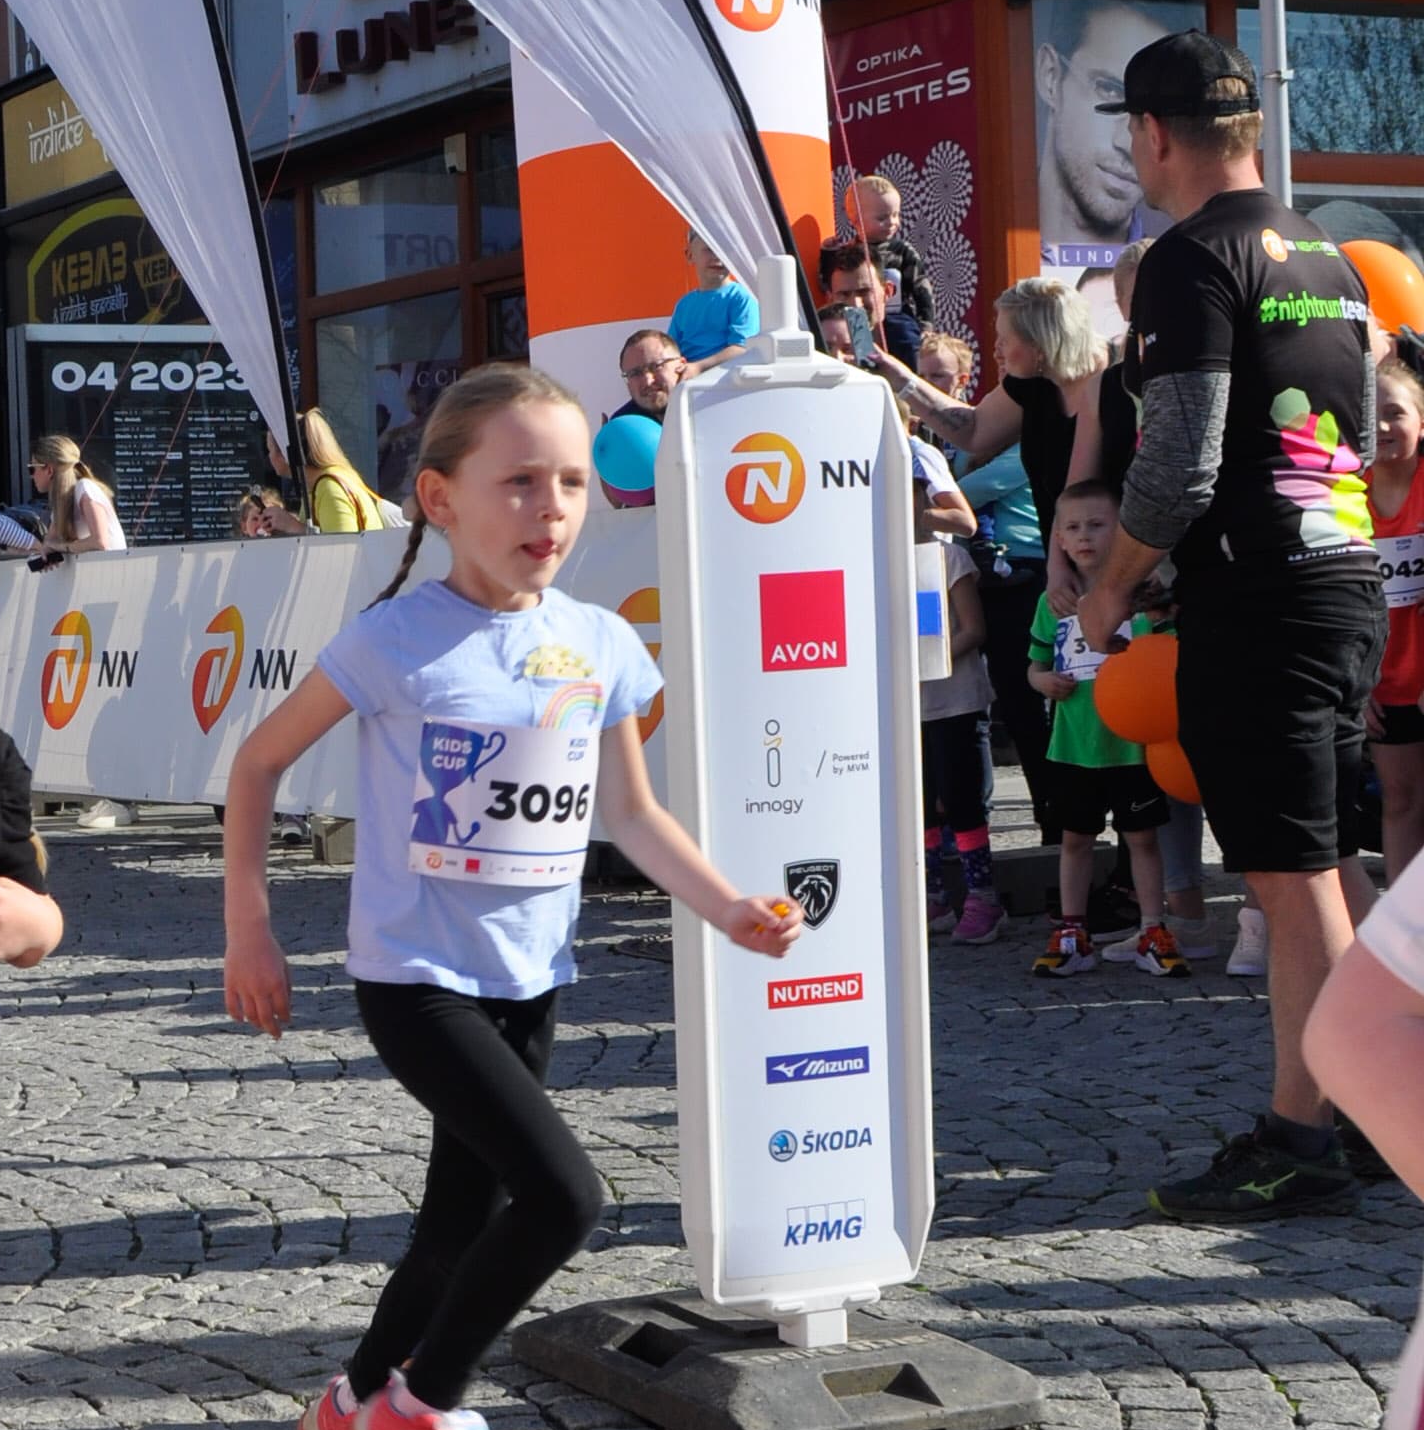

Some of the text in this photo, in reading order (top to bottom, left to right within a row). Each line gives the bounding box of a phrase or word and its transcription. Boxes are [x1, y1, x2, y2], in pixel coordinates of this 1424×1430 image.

[856, 44, 922, 72] OPTIKA
[828, 67, 971, 127] UNETTES
[1260, 291, 1368, 327] #nightruntea
[52, 361, 117, 392] 04
[130, 361, 251, 392] 2023
[820, 459, 871, 489] NN
[770, 641, 838, 663] AVON
[98, 650, 138, 688] NN
[249, 649, 297, 689] NN
[432, 737, 473, 754] KIDS
[832, 751, 870, 762] Powered
[431, 754, 467, 770] CUP
[833, 762, 870, 775] by MVM
[484, 779, 590, 824] 3096
[745, 798, 804, 814] innogy
[772, 979, 860, 1003] NUTREND
[801, 1126, 873, 1155] ŠKODA
[784, 1216, 862, 1247] KPMG
